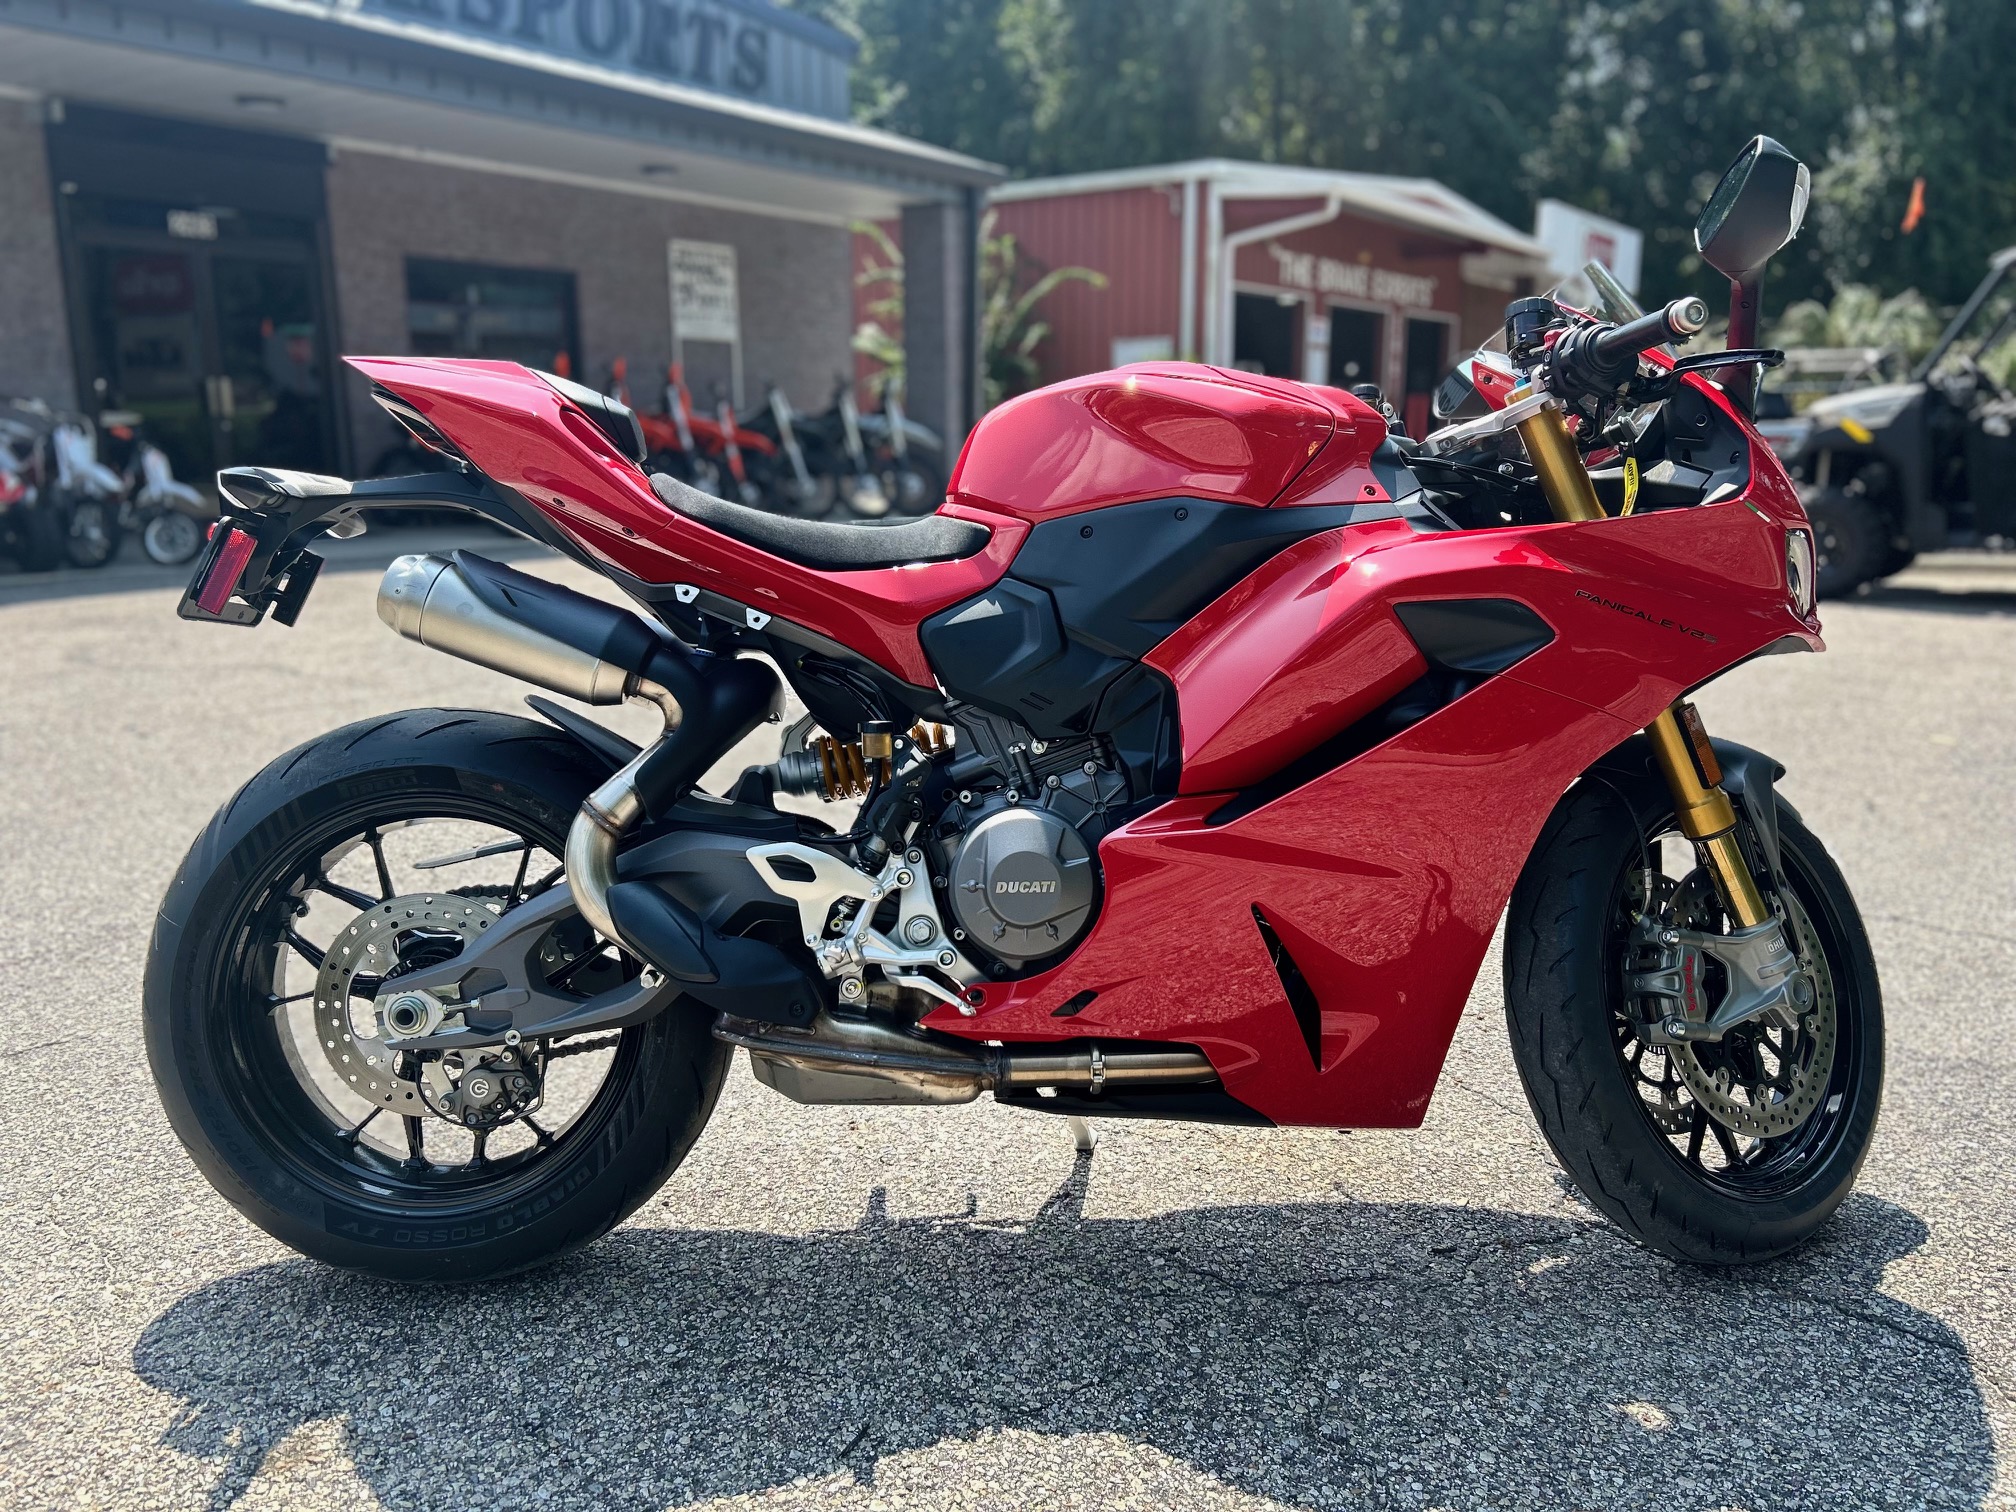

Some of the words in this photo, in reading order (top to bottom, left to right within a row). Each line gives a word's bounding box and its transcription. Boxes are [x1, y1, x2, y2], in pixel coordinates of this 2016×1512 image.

[995, 881, 1057, 893] DUCATI
[1682, 954, 1697, 1012] brembo
[496, 1165, 593, 1230] DIABLO
[393, 1223, 487, 1243] ROSSO
